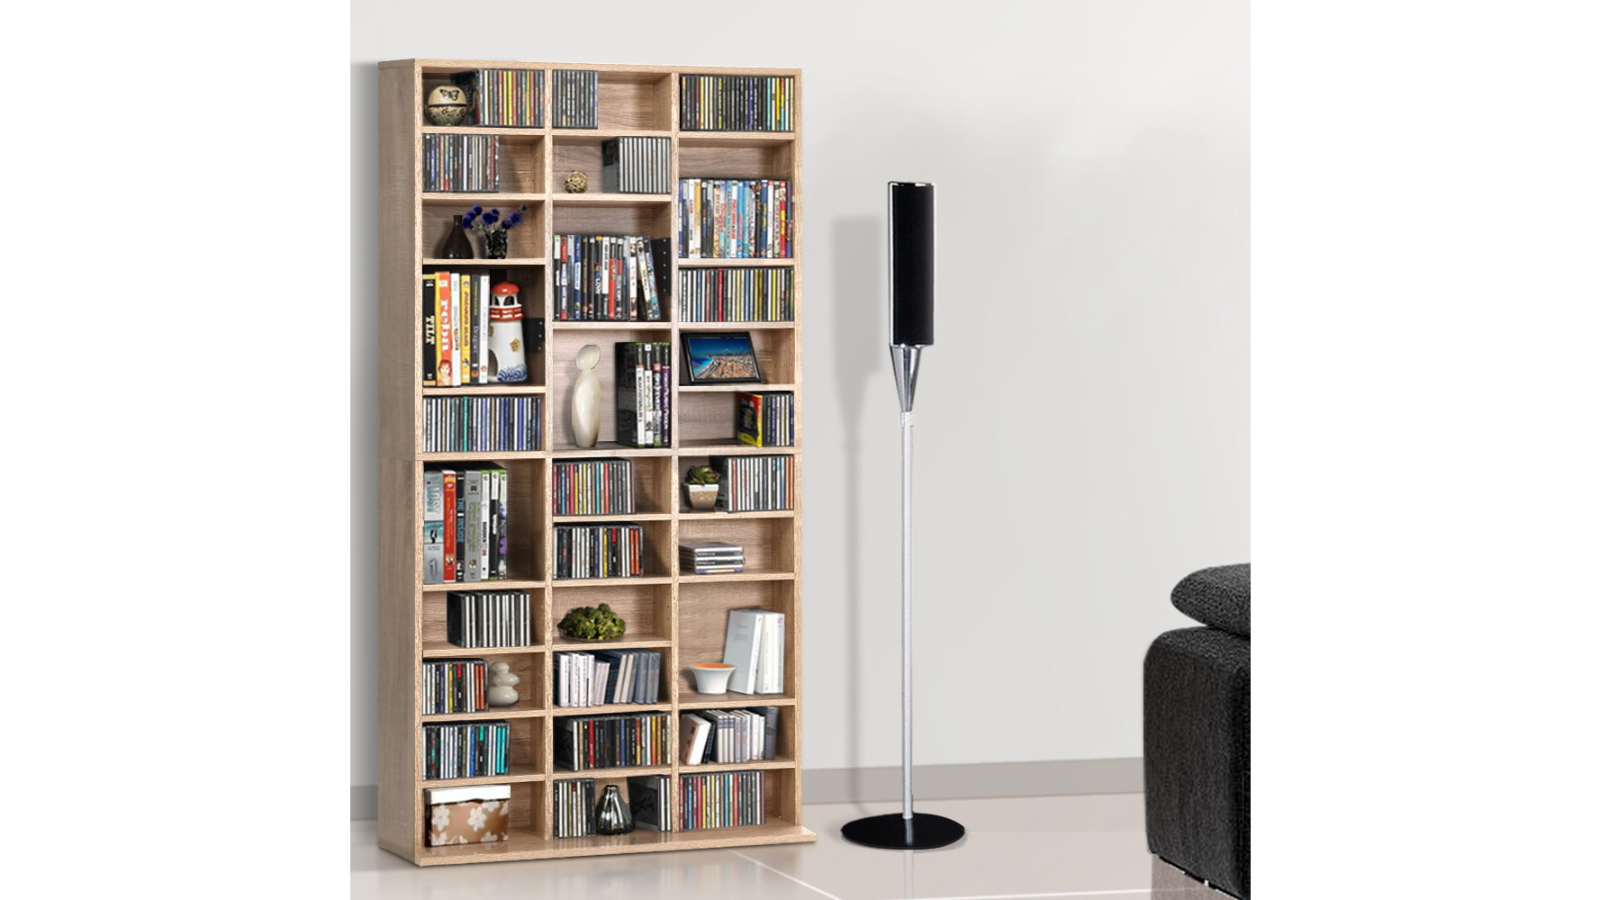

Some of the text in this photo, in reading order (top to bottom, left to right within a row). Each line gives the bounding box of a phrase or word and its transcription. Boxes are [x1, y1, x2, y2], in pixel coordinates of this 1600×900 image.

[425, 315, 435, 345] TILT
[441, 300, 450, 352] reba
[426, 487, 440, 514] LOST
